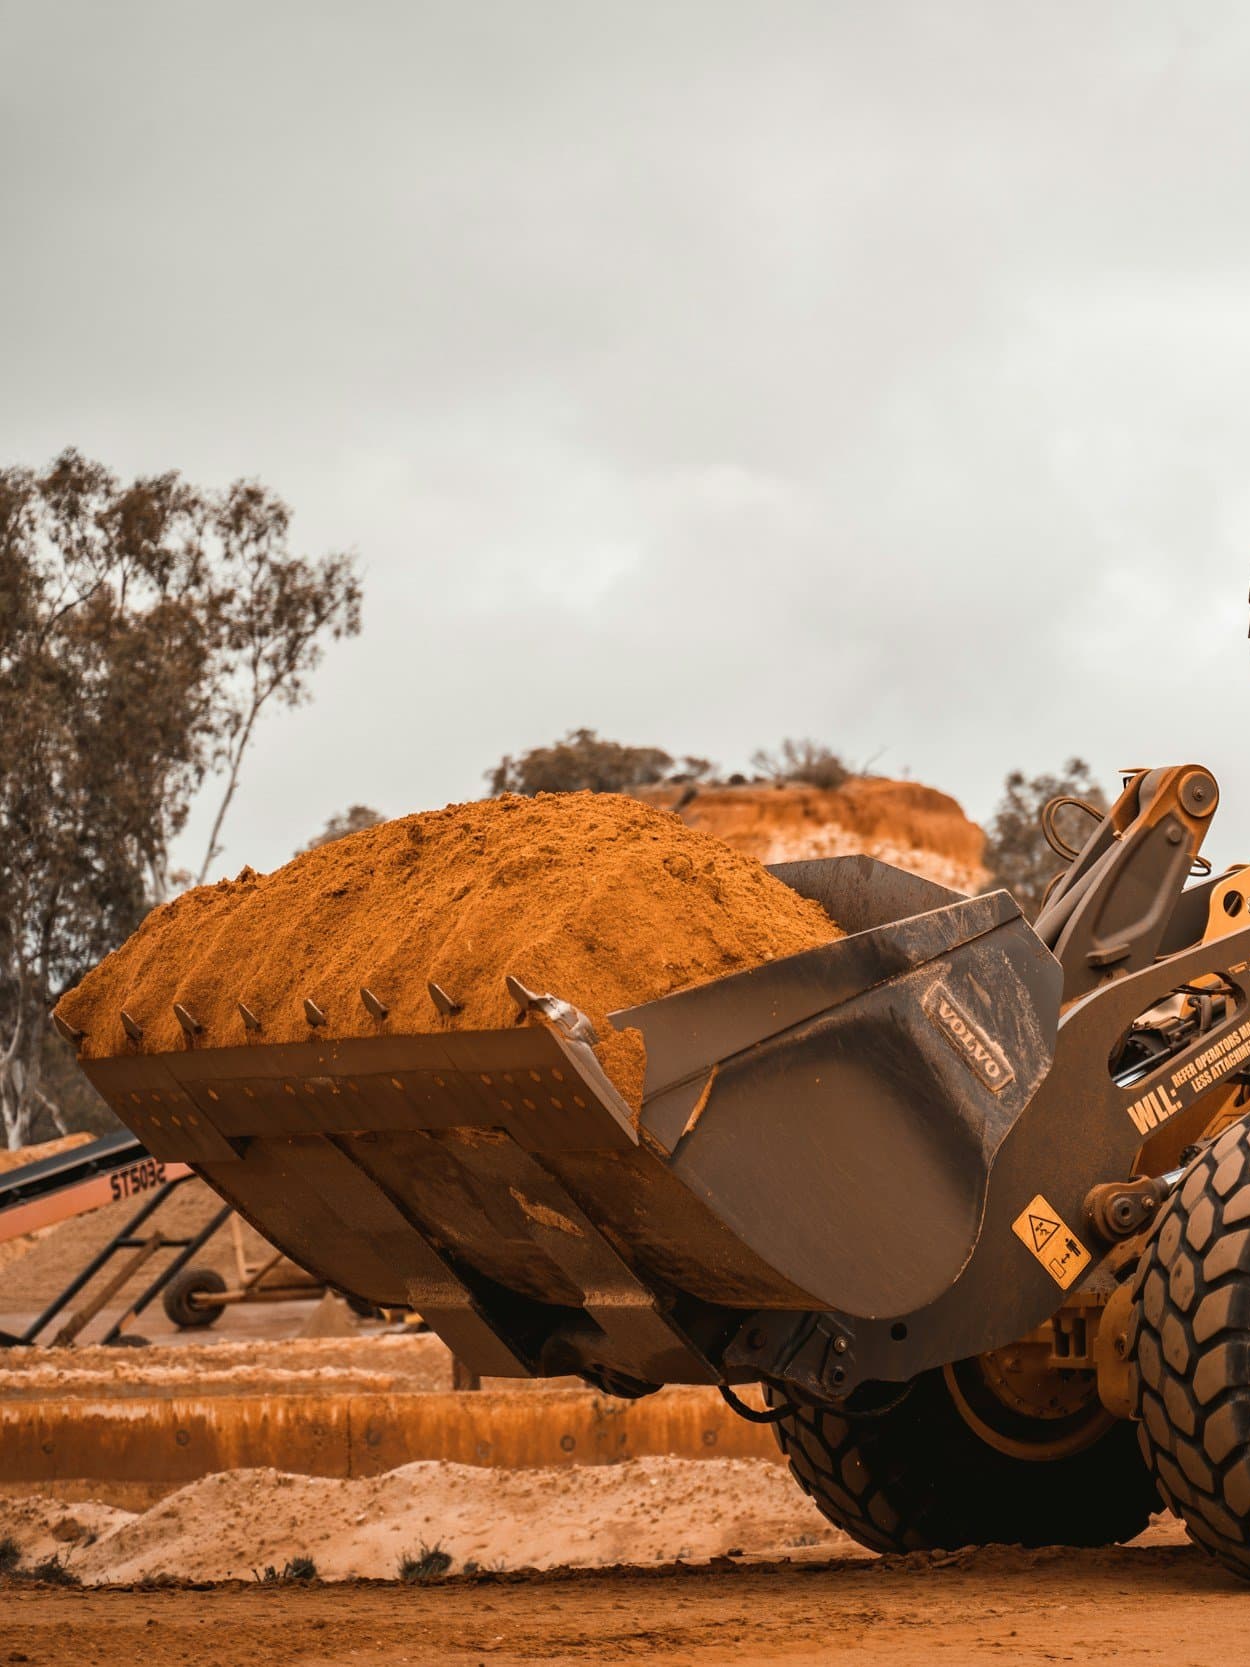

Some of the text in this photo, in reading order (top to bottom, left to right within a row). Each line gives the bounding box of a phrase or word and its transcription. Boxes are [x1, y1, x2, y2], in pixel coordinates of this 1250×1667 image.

[939, 996, 1001, 1078] VOLVO
[1171, 1062, 1199, 1089] REFER
[1195, 1030, 1242, 1071] OPERATORS
[1191, 1070, 1214, 1093] LESS
[1126, 1084, 1183, 1136] WLL:
